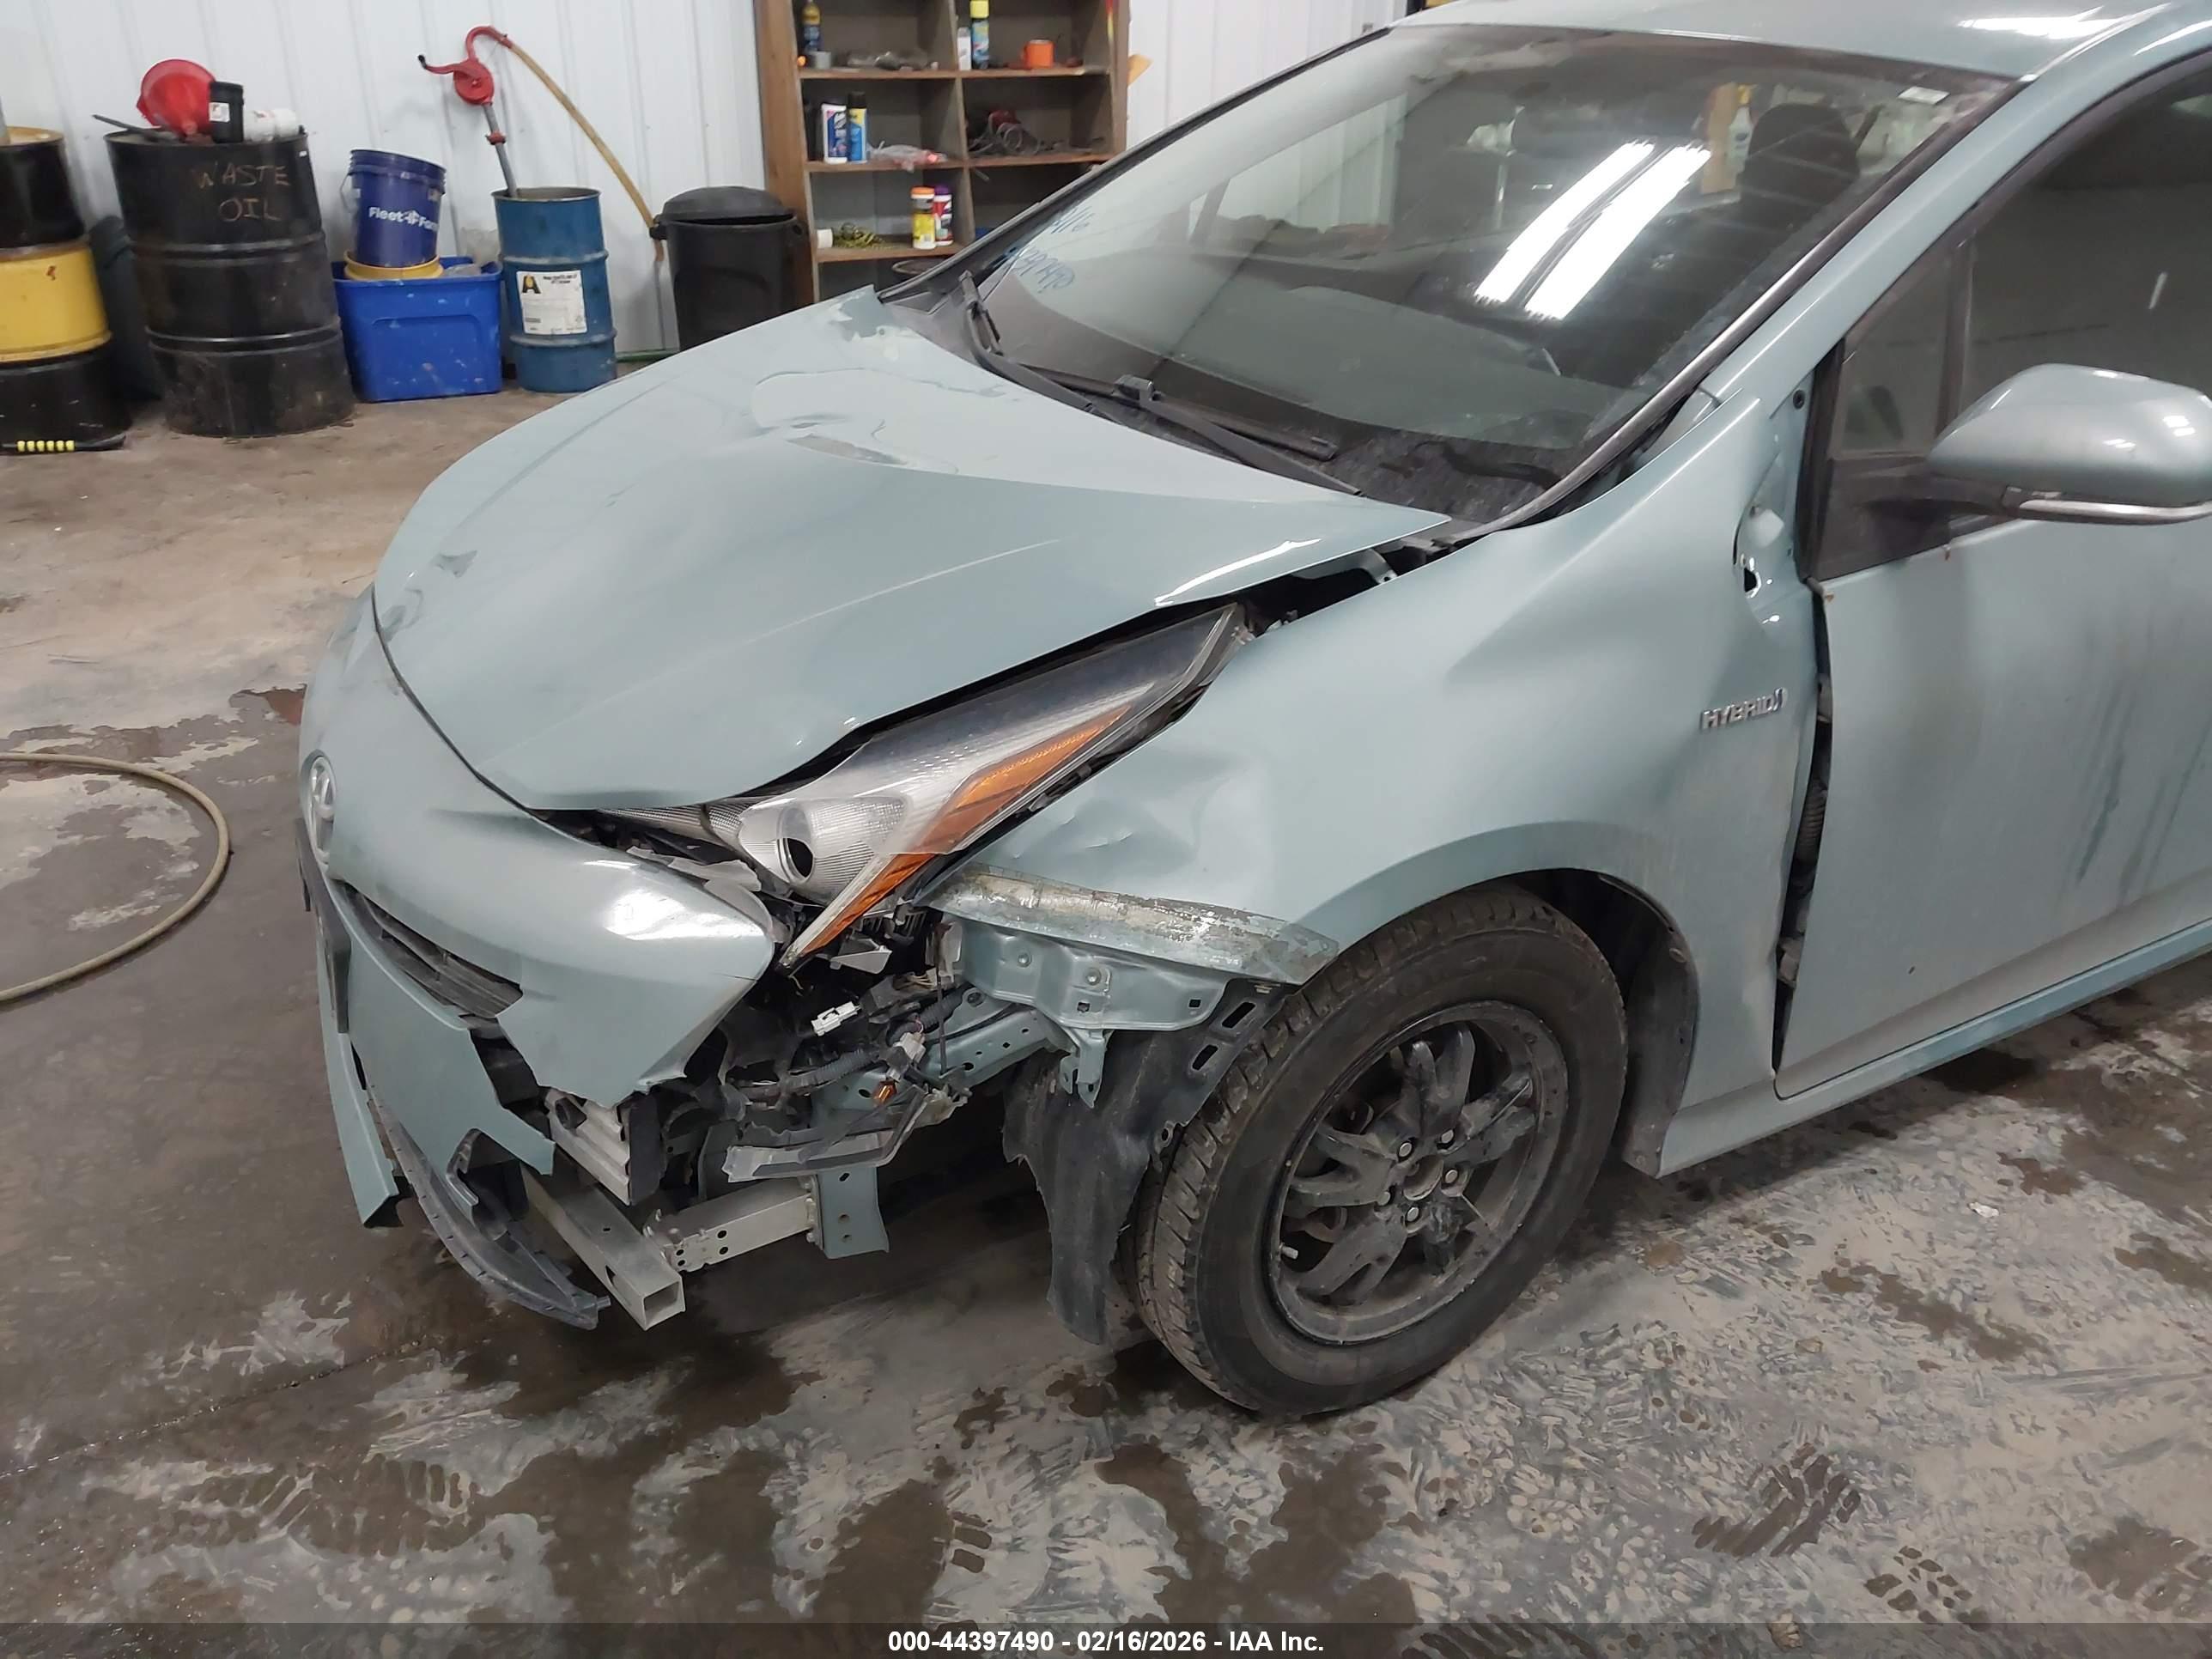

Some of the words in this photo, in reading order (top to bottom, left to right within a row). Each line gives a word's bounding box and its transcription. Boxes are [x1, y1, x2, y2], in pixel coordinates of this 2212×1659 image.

[190, 161, 291, 188] WASTE
[219, 197, 282, 222] OIL
[368, 206, 404, 223] Fleet
[1700, 694, 1774, 730] HYBRID
